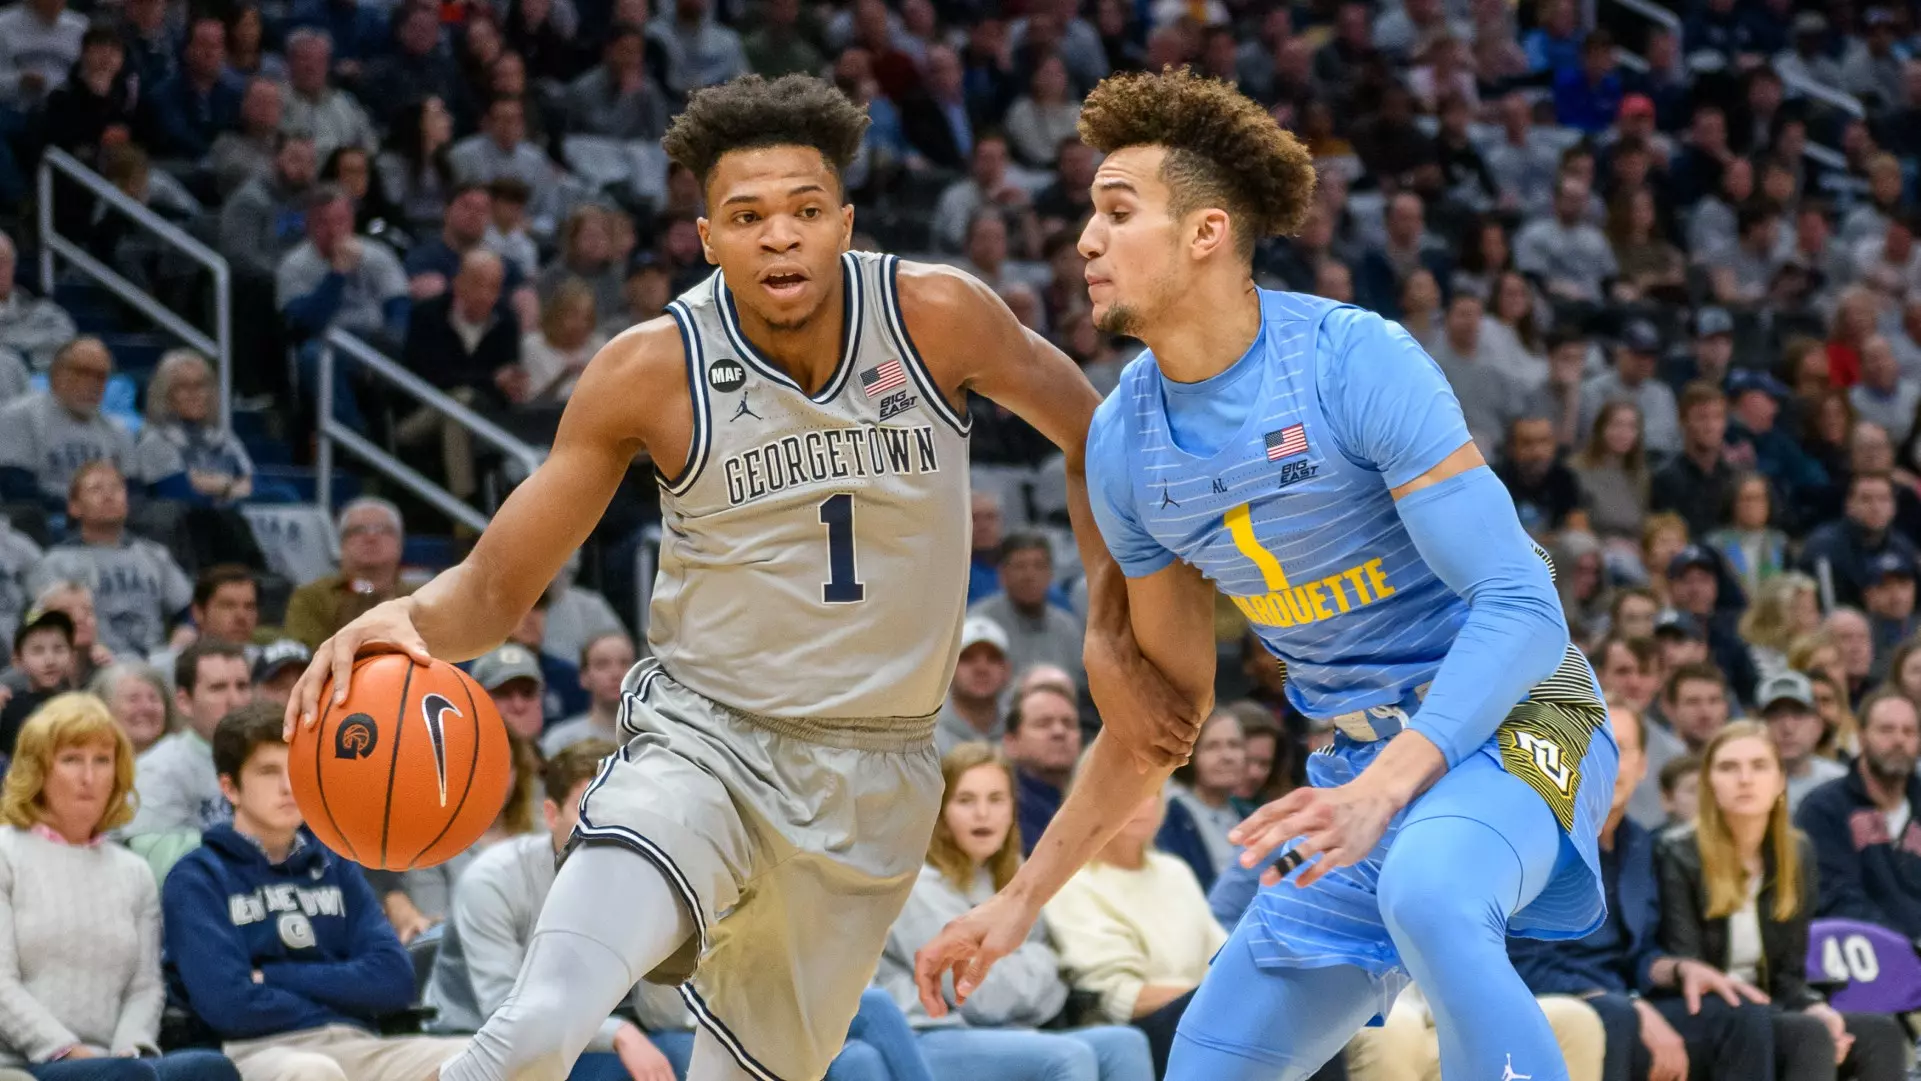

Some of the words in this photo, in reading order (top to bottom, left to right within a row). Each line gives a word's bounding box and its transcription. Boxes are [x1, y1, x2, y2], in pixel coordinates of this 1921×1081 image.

[711, 366, 742, 384] MAF
[880, 389, 906, 409] BIG
[880, 396, 918, 418] EAST
[725, 426, 939, 505] GEORGETOWN
[1280, 466, 1319, 484] EAST
[1281, 459, 1308, 475] BIG
[1212, 478, 1228, 494] AL
[819, 493, 865, 604] 1
[1224, 502, 1290, 591] 1
[1231, 557, 1395, 628] ARQUETTE
[1822, 934, 1880, 983] 40
